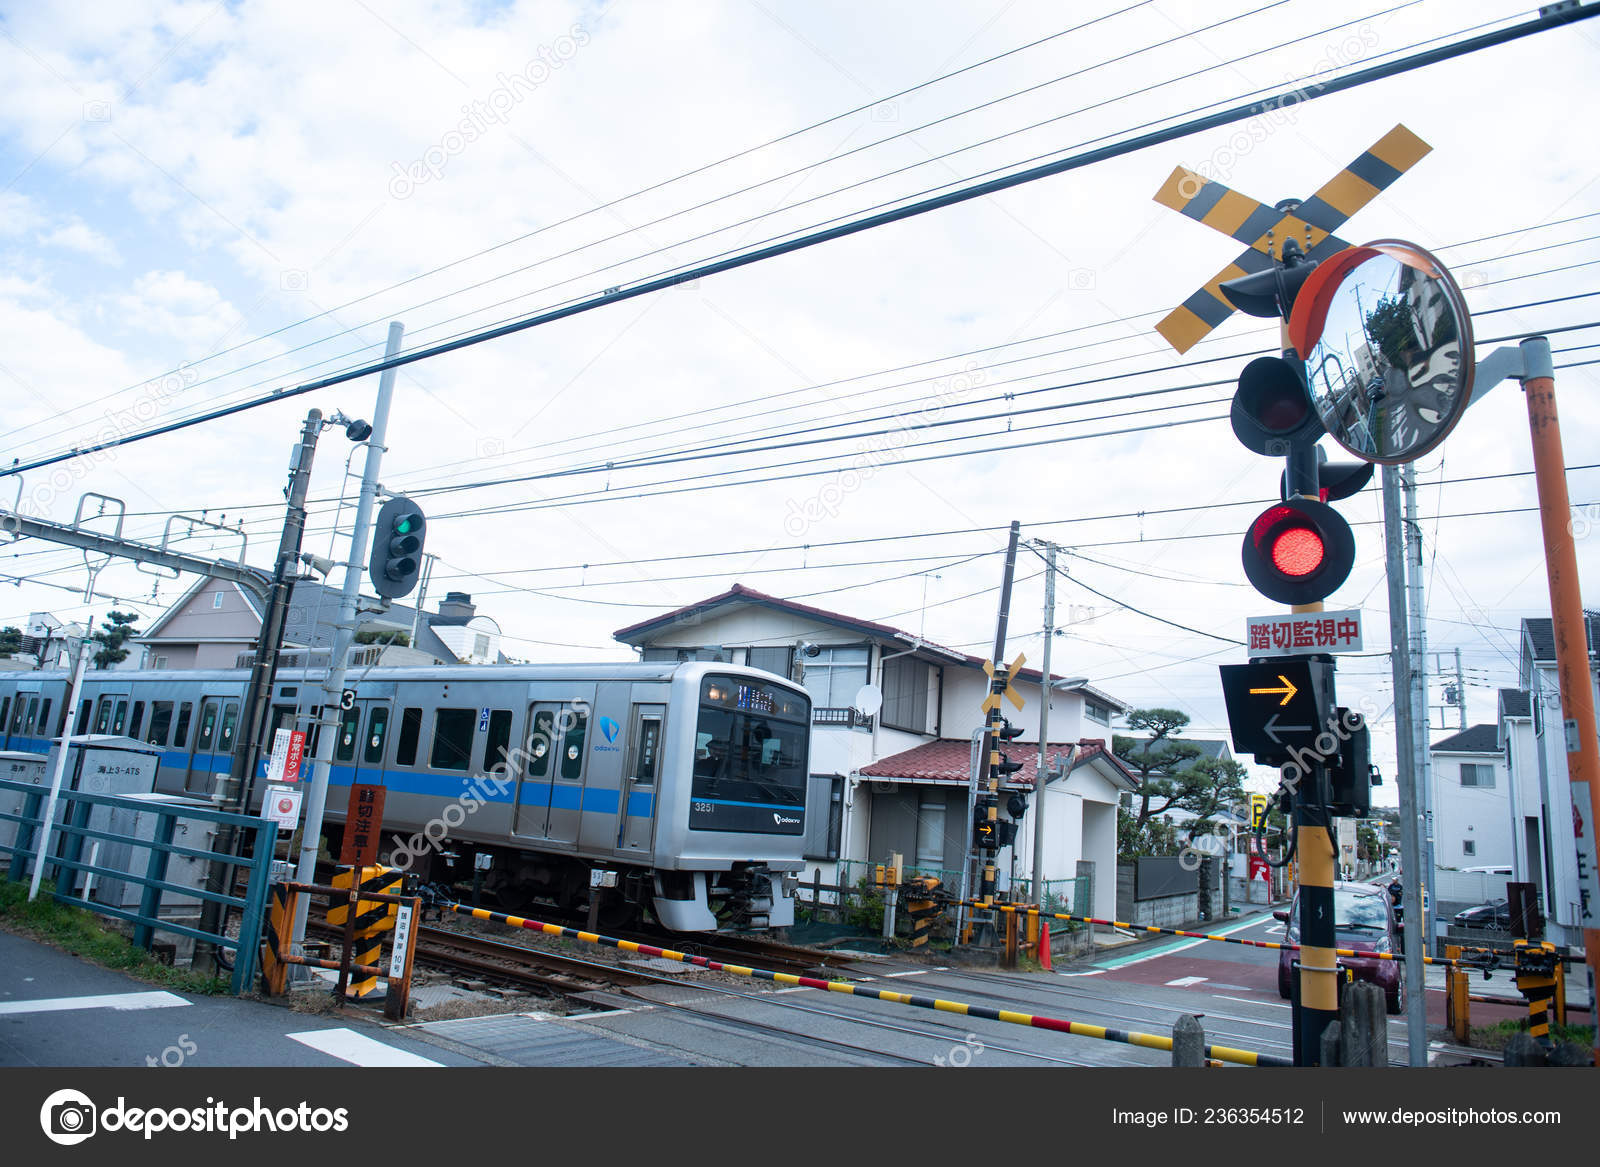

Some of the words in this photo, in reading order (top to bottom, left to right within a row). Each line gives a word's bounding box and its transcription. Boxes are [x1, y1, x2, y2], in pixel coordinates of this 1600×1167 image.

[1250, 617, 1358, 650] 踏切監視中
[341, 691, 355, 710] 3
[287, 734, 303, 778] 非常ボタン
[695, 802, 714, 813] 3251
